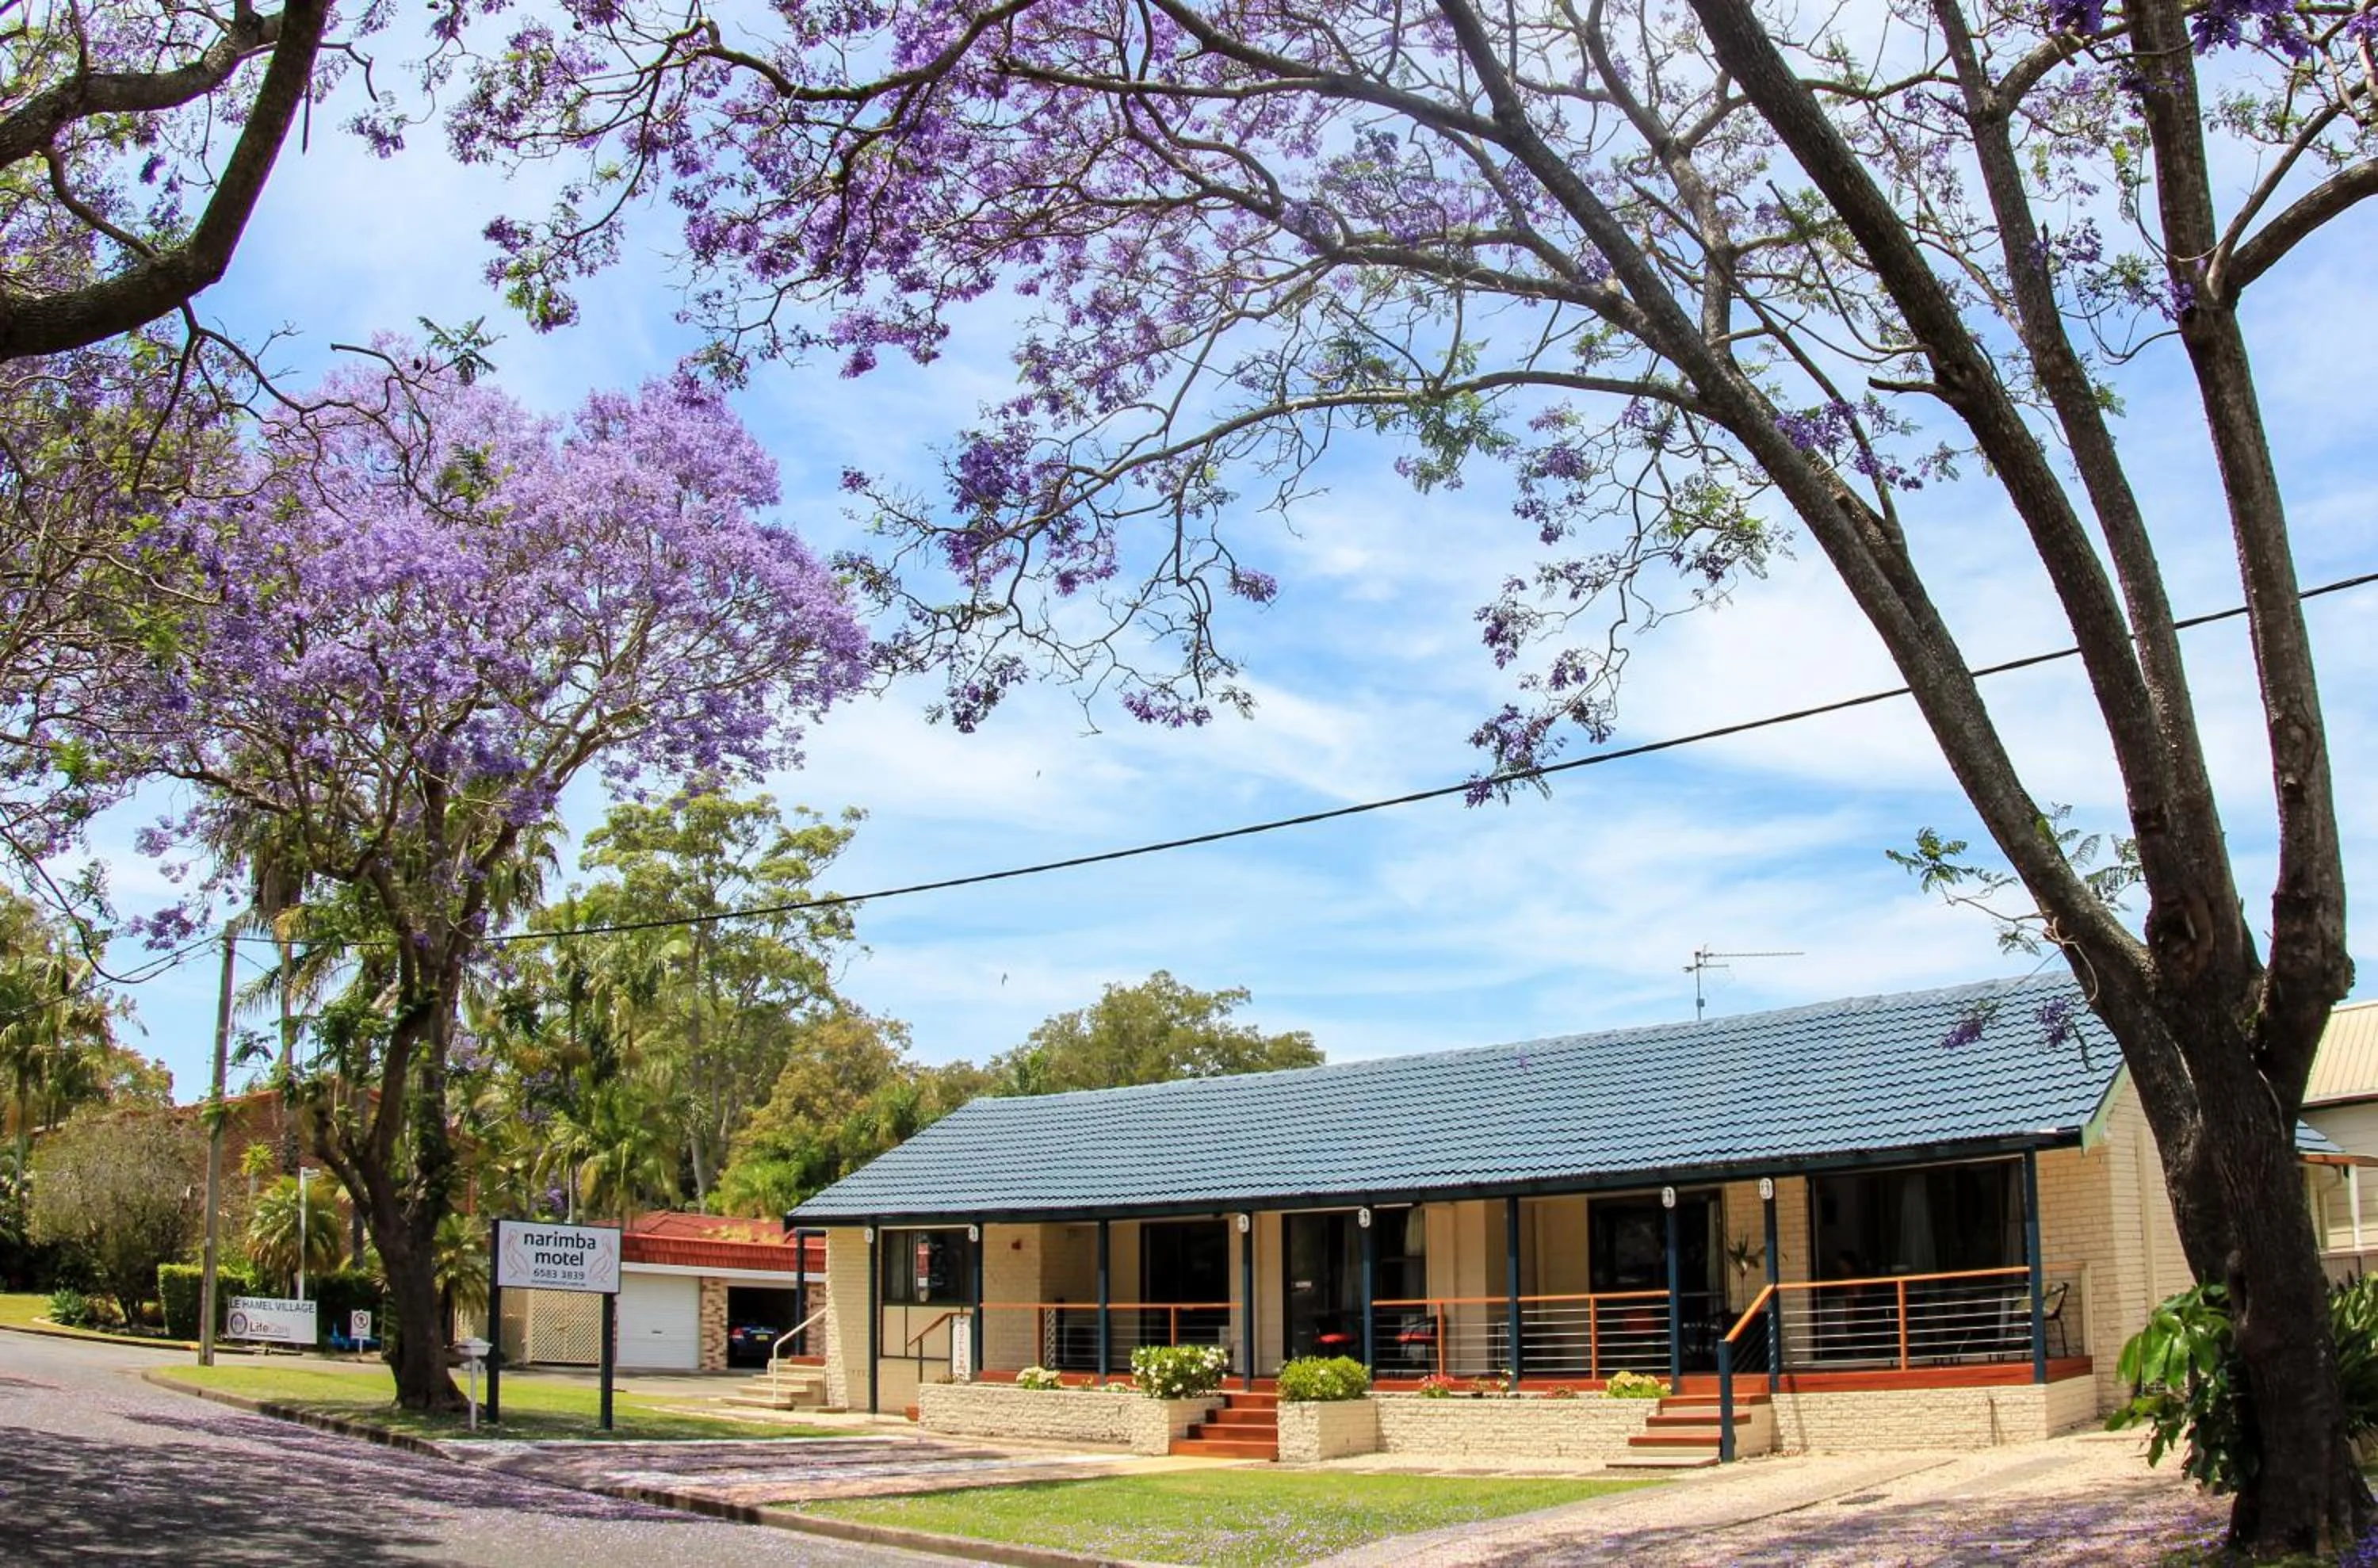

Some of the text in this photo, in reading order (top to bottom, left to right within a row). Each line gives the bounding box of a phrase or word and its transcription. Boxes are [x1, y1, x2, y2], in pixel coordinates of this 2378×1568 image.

[524, 1231, 596, 1250] narimba
[535, 1251, 584, 1266] motel
[533, 1268, 557, 1279] 6583
[229, 1298, 315, 1313] LE HAMEL VILLAGE
